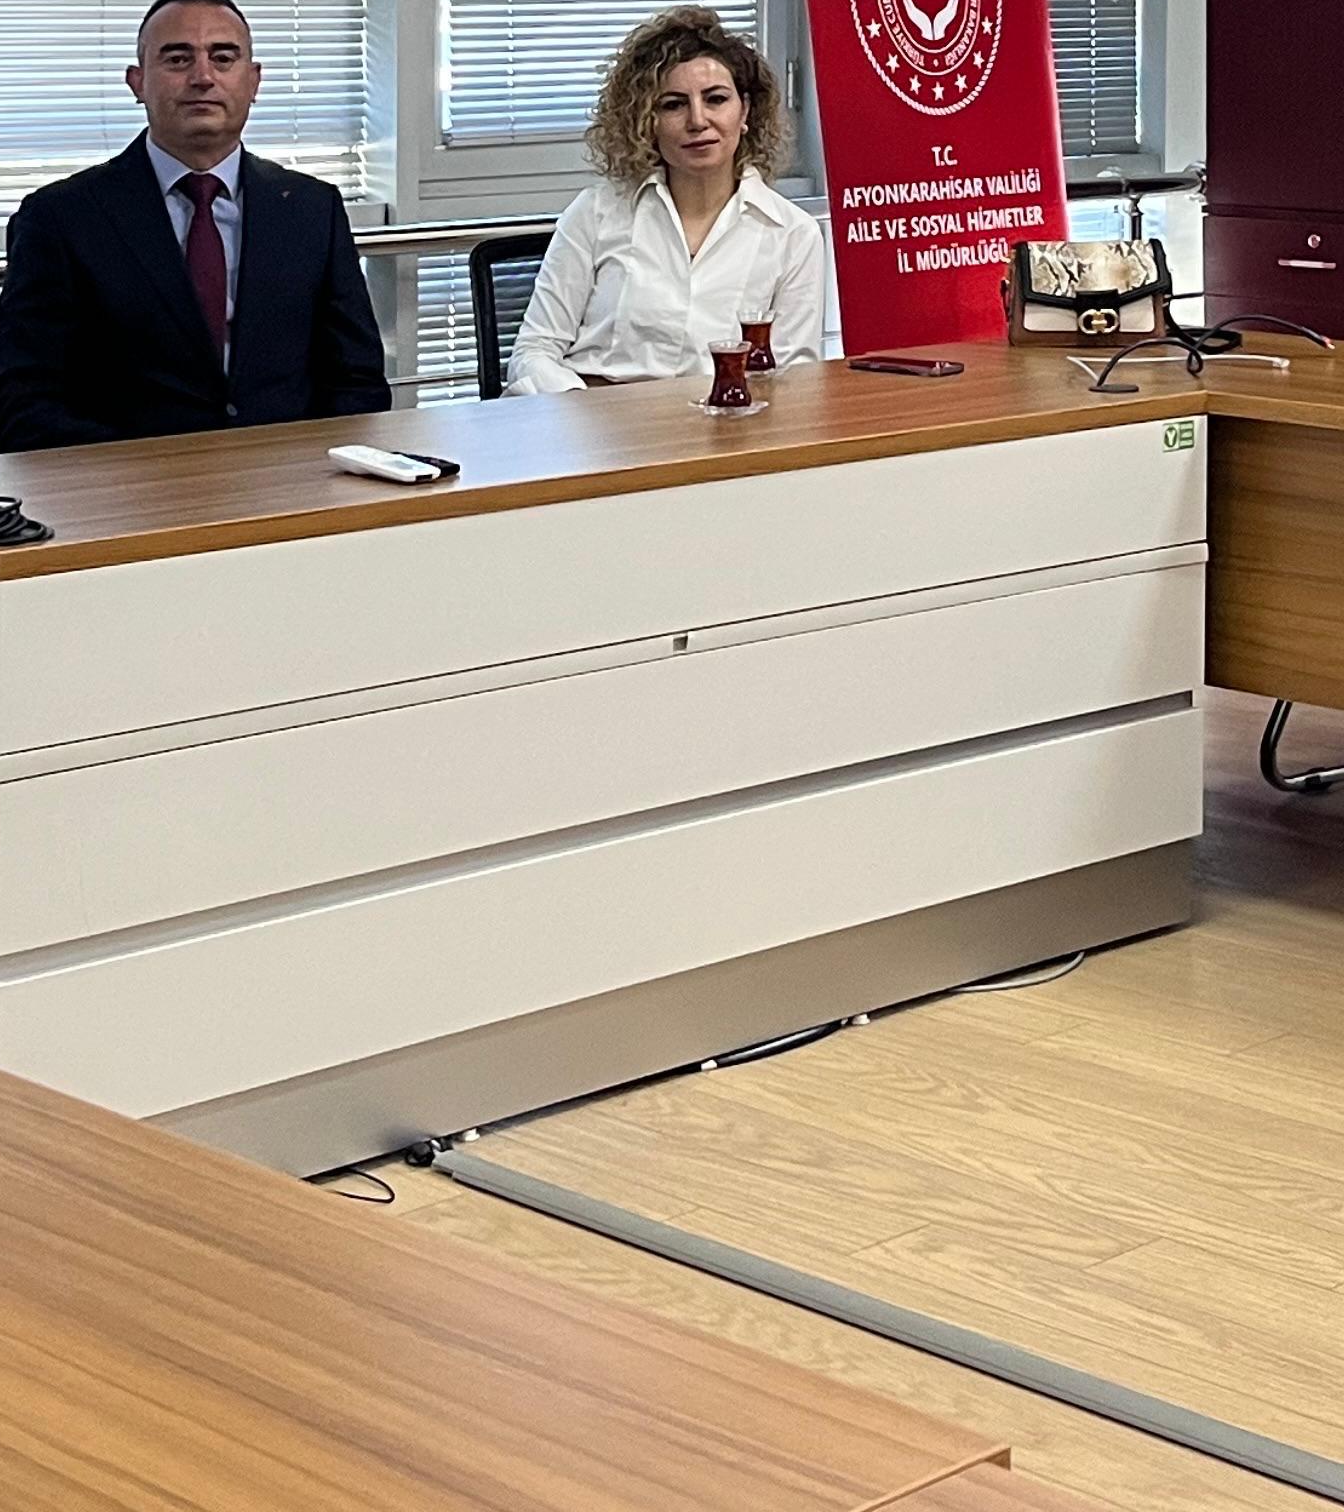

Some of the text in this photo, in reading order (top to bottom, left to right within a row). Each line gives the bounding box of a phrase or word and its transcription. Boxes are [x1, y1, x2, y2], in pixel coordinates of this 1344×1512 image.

[931, 145, 958, 167] T.C.
[843, 168, 1041, 208] AFYONKARAHİSAR VALİLİĞİ
[847, 206, 1044, 243] AİLE VE SOSYAL HİZMETLER
[896, 238, 1010, 274] İL MÜDÜRLÜĞÜ
